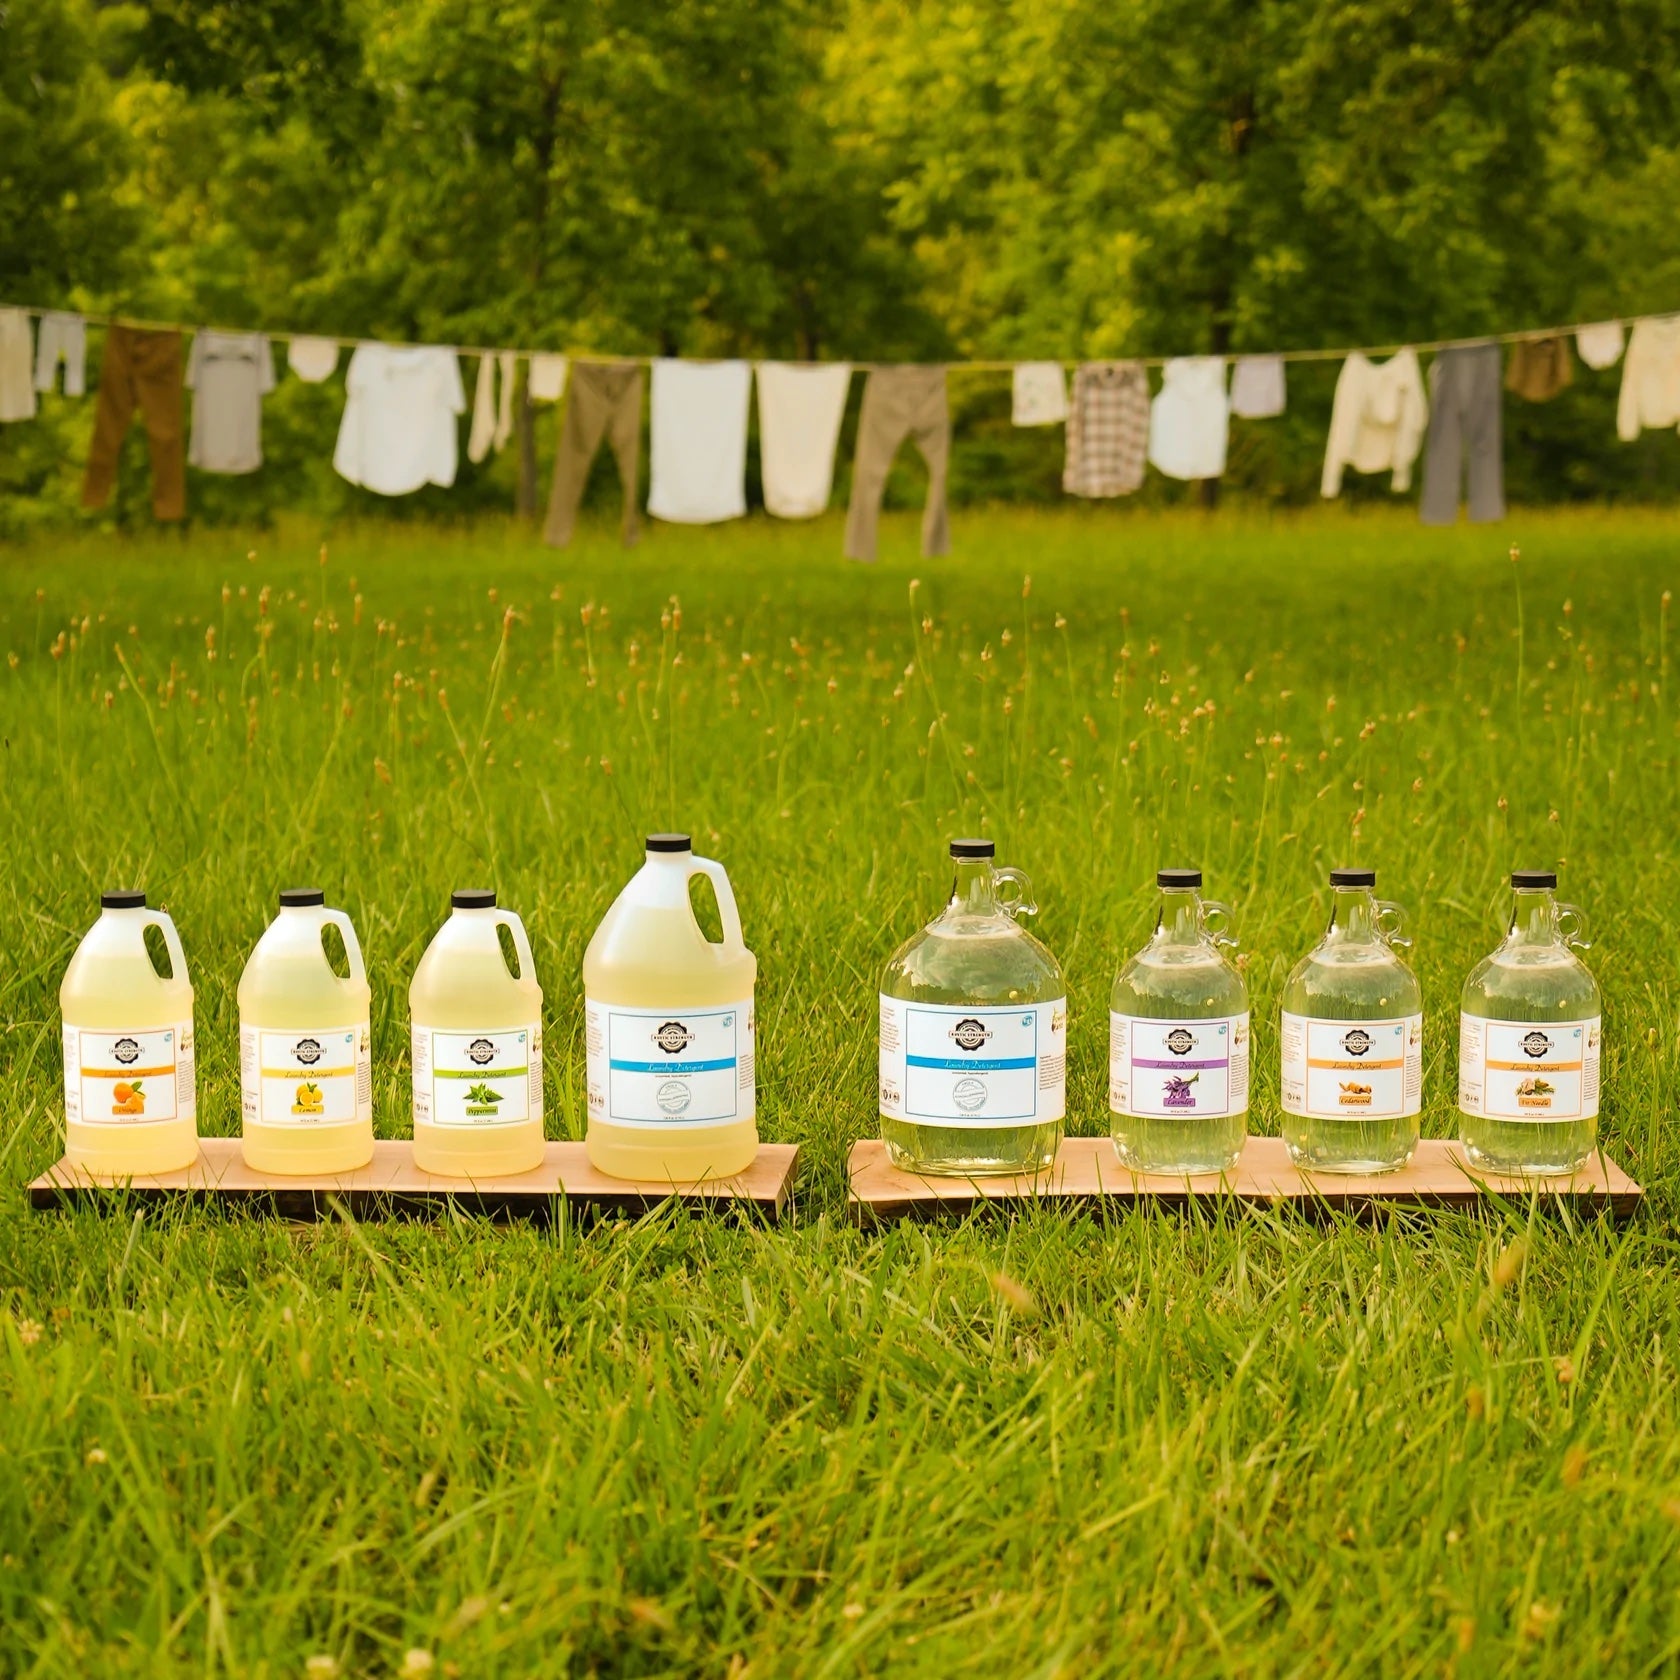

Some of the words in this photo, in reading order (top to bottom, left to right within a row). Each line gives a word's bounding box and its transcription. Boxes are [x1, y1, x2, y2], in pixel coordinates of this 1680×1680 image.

[648, 1062, 673, 1072] Laundry
[674, 1063, 704, 1072] Detergent
[944, 1059, 970, 1070] Laundry
[971, 1060, 1001, 1069] Detergent
[1155, 1061, 1178, 1070] Laundry
[1179, 1061, 1205, 1069] Detergent
[1332, 1061, 1356, 1070] Laundry
[1356, 1061, 1382, 1070] Detergent
[1510, 1064, 1534, 1073] Laundry
[1534, 1064, 1560, 1073] Detergent
[284, 1071, 307, 1079] Laundry
[308, 1070, 333, 1078] Detergent
[458, 1071, 481, 1080] Laundry
[482, 1070, 507, 1079] Detergent
[1167, 1098, 1193, 1106] Lavender
